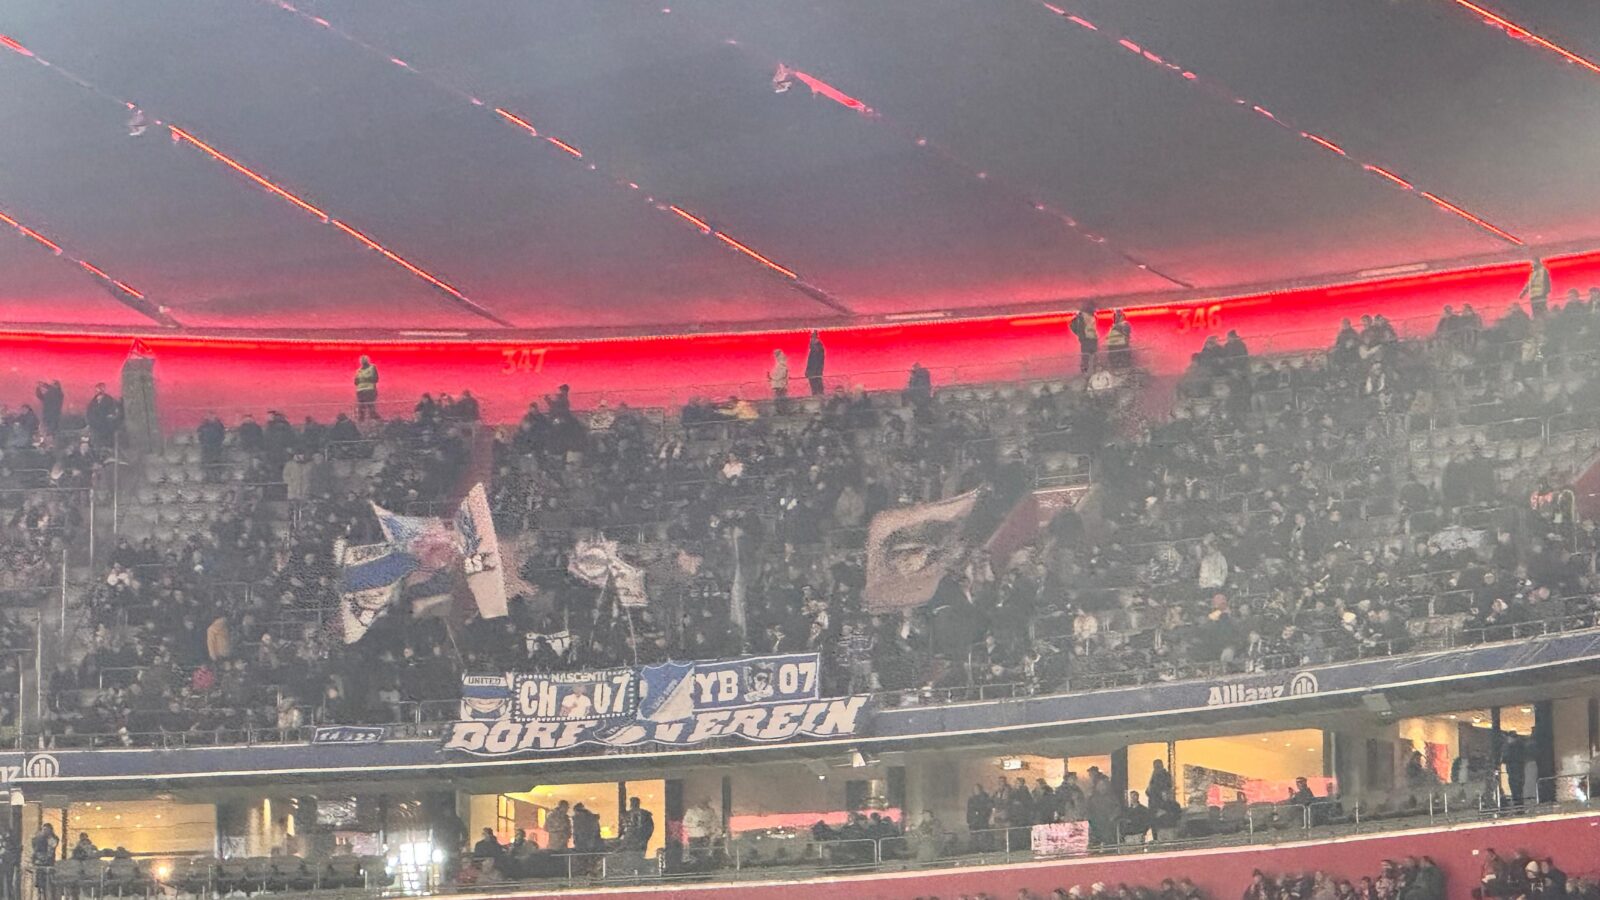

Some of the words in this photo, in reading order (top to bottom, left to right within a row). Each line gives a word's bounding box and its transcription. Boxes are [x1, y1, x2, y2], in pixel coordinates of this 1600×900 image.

[1176, 305, 1222, 333] 346
[501, 348, 547, 375] 347
[779, 662, 816, 694] 07
[1207, 684, 1285, 706] Allianz
[444, 719, 599, 752] DORF
[654, 696, 868, 743] VEREIN
